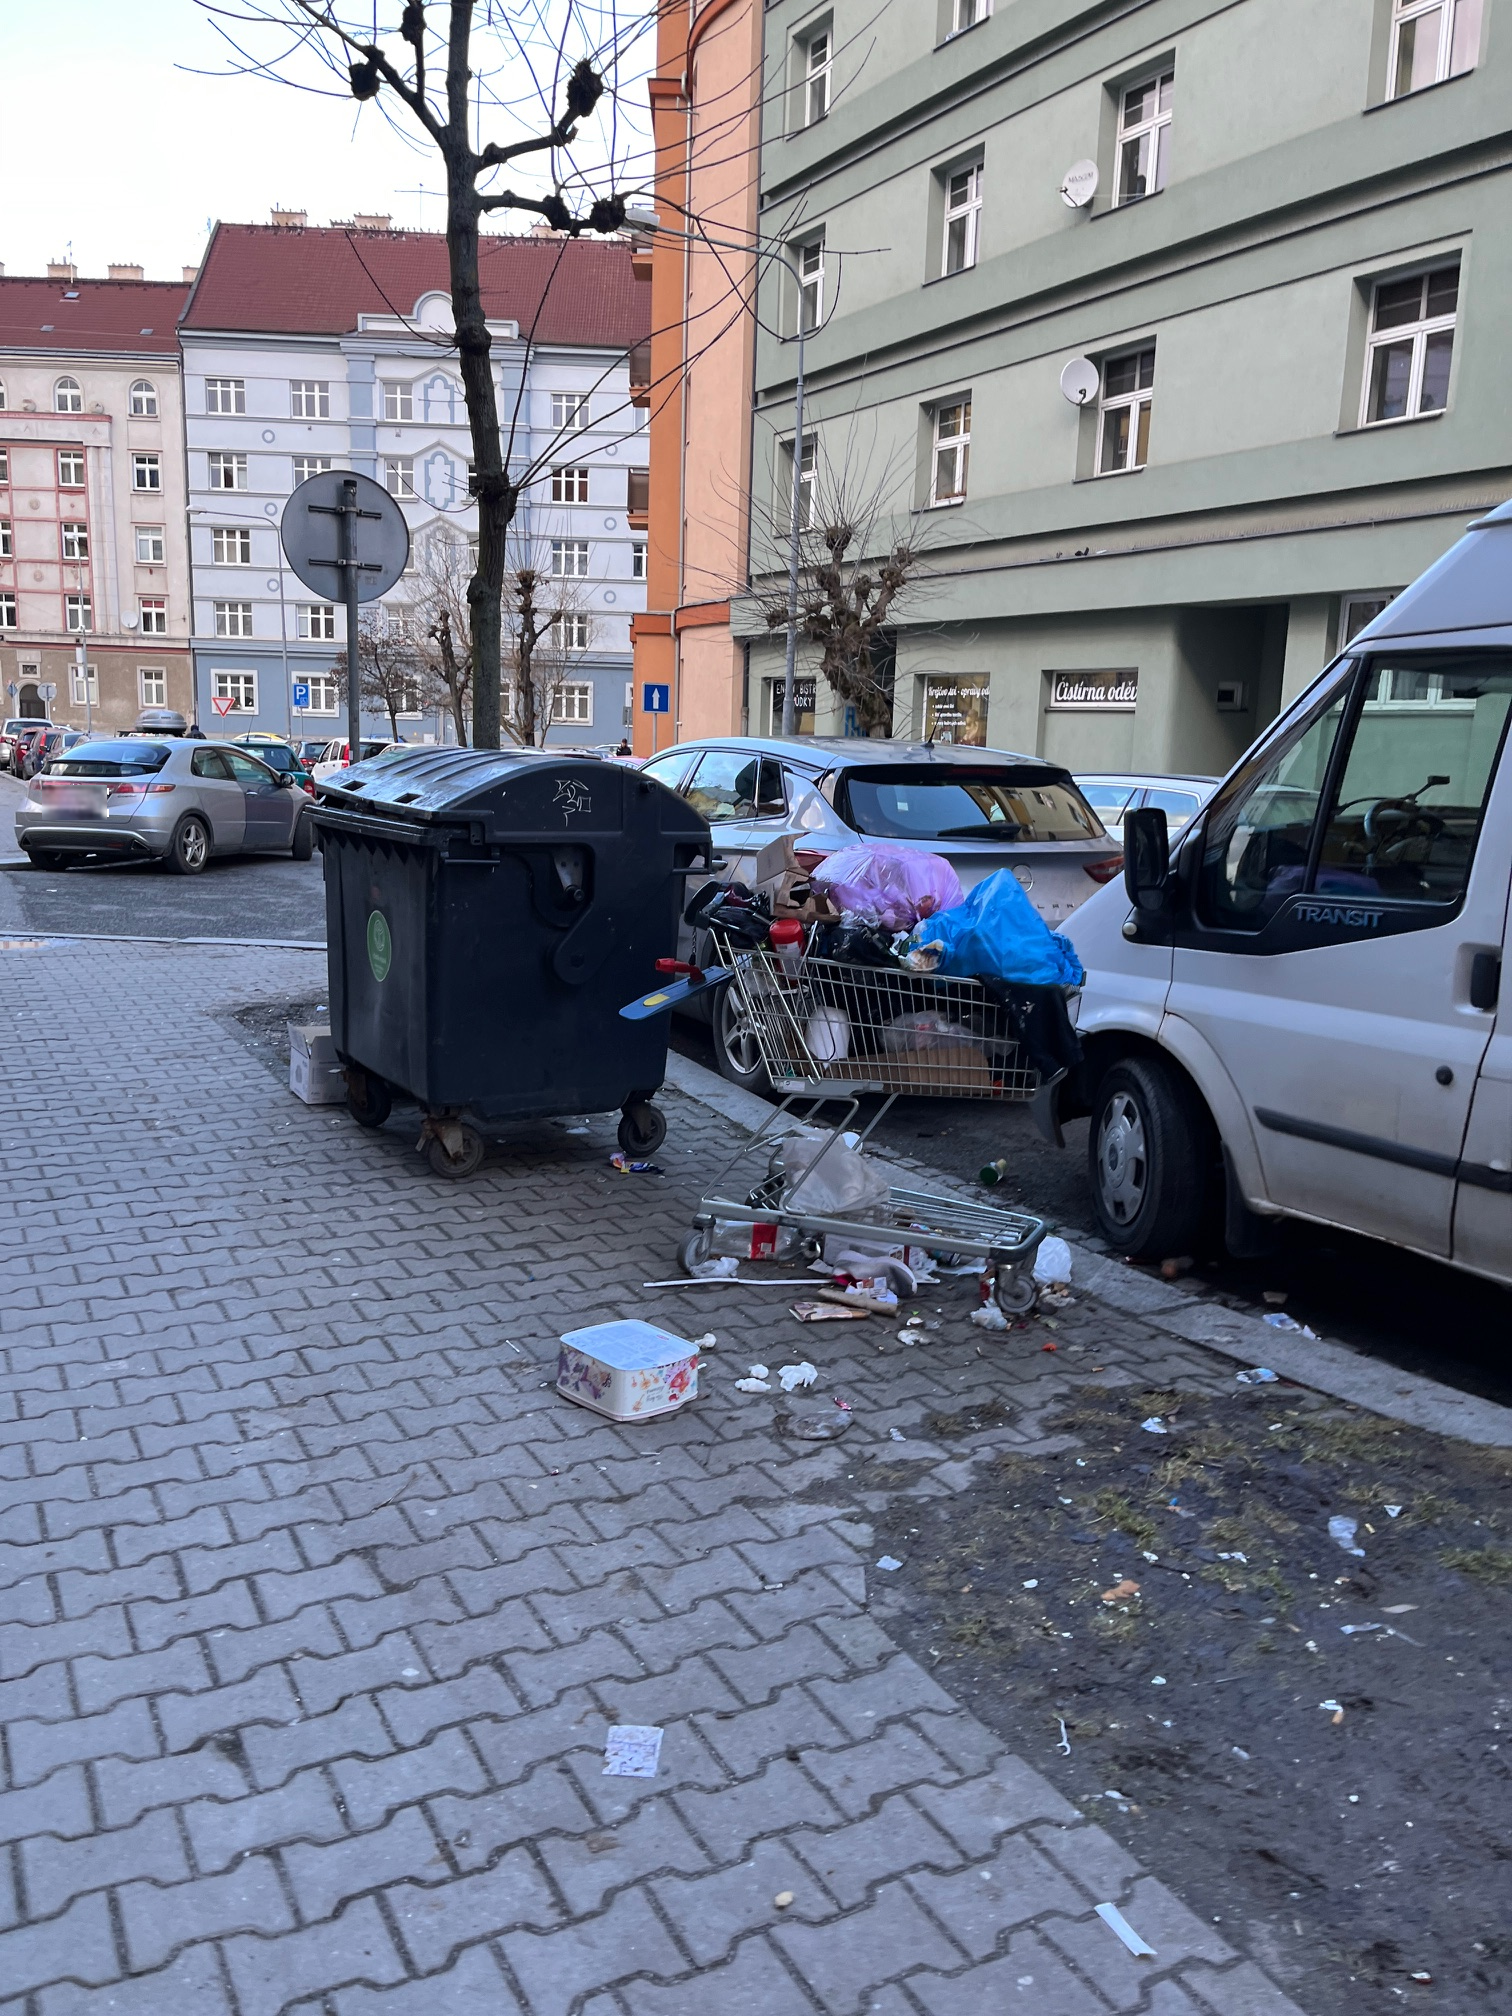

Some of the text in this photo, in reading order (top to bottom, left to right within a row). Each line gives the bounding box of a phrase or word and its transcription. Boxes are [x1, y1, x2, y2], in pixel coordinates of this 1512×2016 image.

[296, 686, 306, 699] P
[1056, 675, 1106, 701] Čistírna
[1295, 905, 1384, 928] TRANSIT
